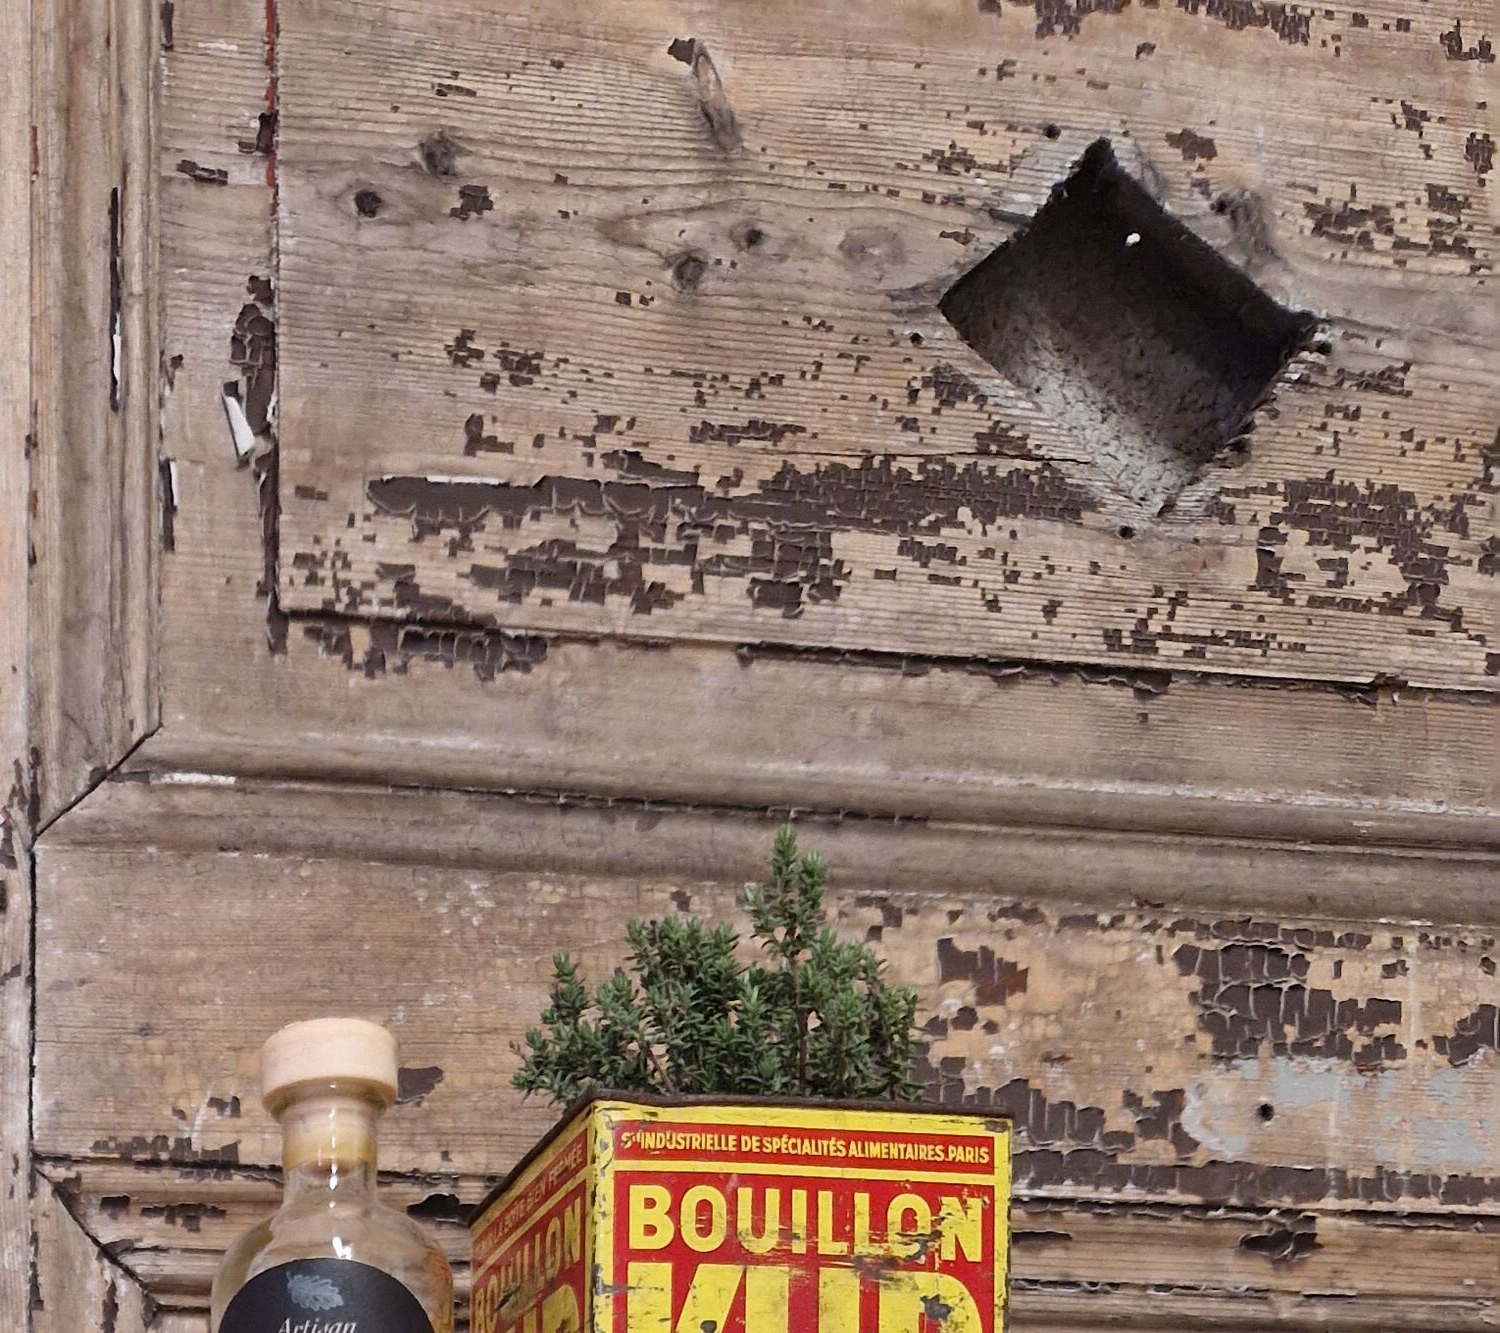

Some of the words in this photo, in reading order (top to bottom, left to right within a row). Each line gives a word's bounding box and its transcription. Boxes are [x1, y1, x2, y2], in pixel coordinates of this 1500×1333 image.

[641, 1131, 738, 1152] INDUSTRIELLE
[741, 1136, 760, 1153] DE
[762, 1135, 847, 1157] SPÉCIALITÉS
[948, 1145, 990, 1164] PARIS
[628, 1184, 983, 1263] BOUILLON
